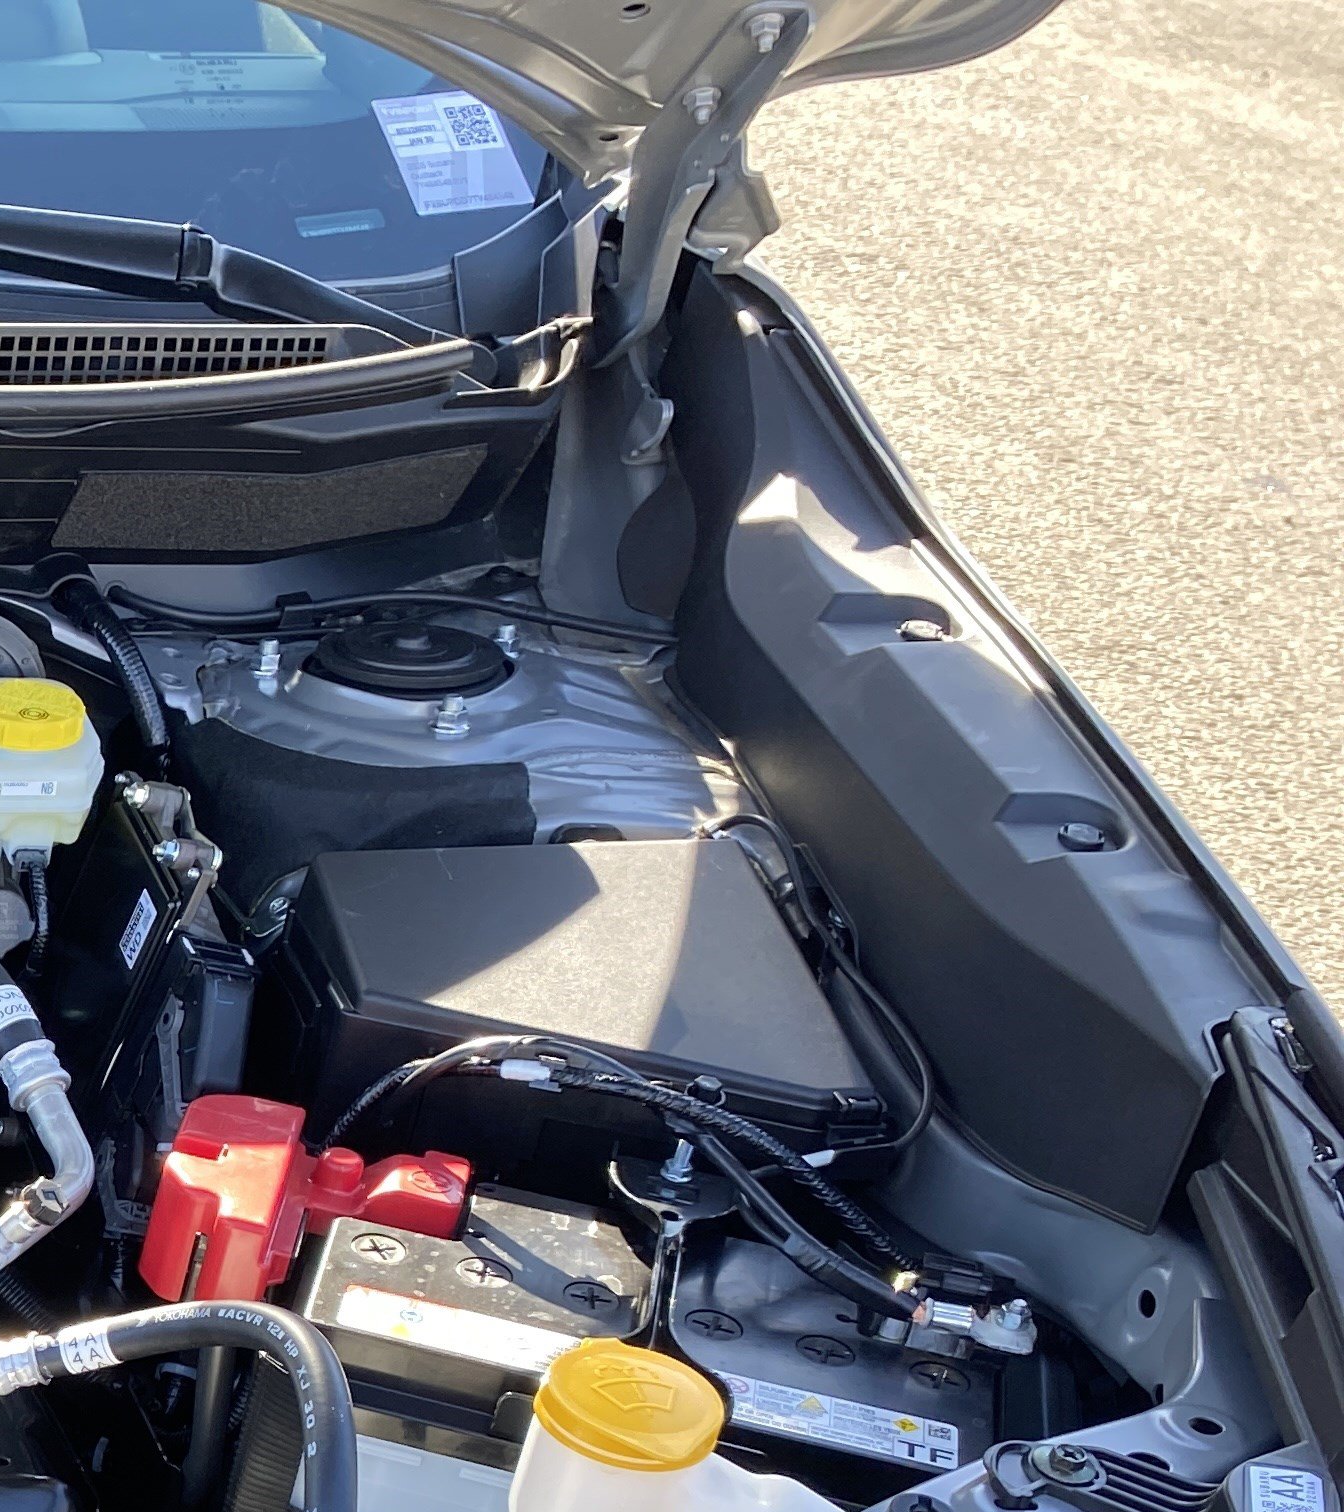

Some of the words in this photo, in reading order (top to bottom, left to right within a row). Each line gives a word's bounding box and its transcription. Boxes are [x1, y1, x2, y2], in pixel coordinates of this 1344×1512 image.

[154, 1307, 212, 1323] YOKOHAMA
[283, 1338, 300, 1359] HP
[296, 1363, 311, 1391] XJ
[304, 1400, 316, 1430] 30
[897, 1439, 955, 1464] TF
[1270, 1474, 1305, 1502] AA
